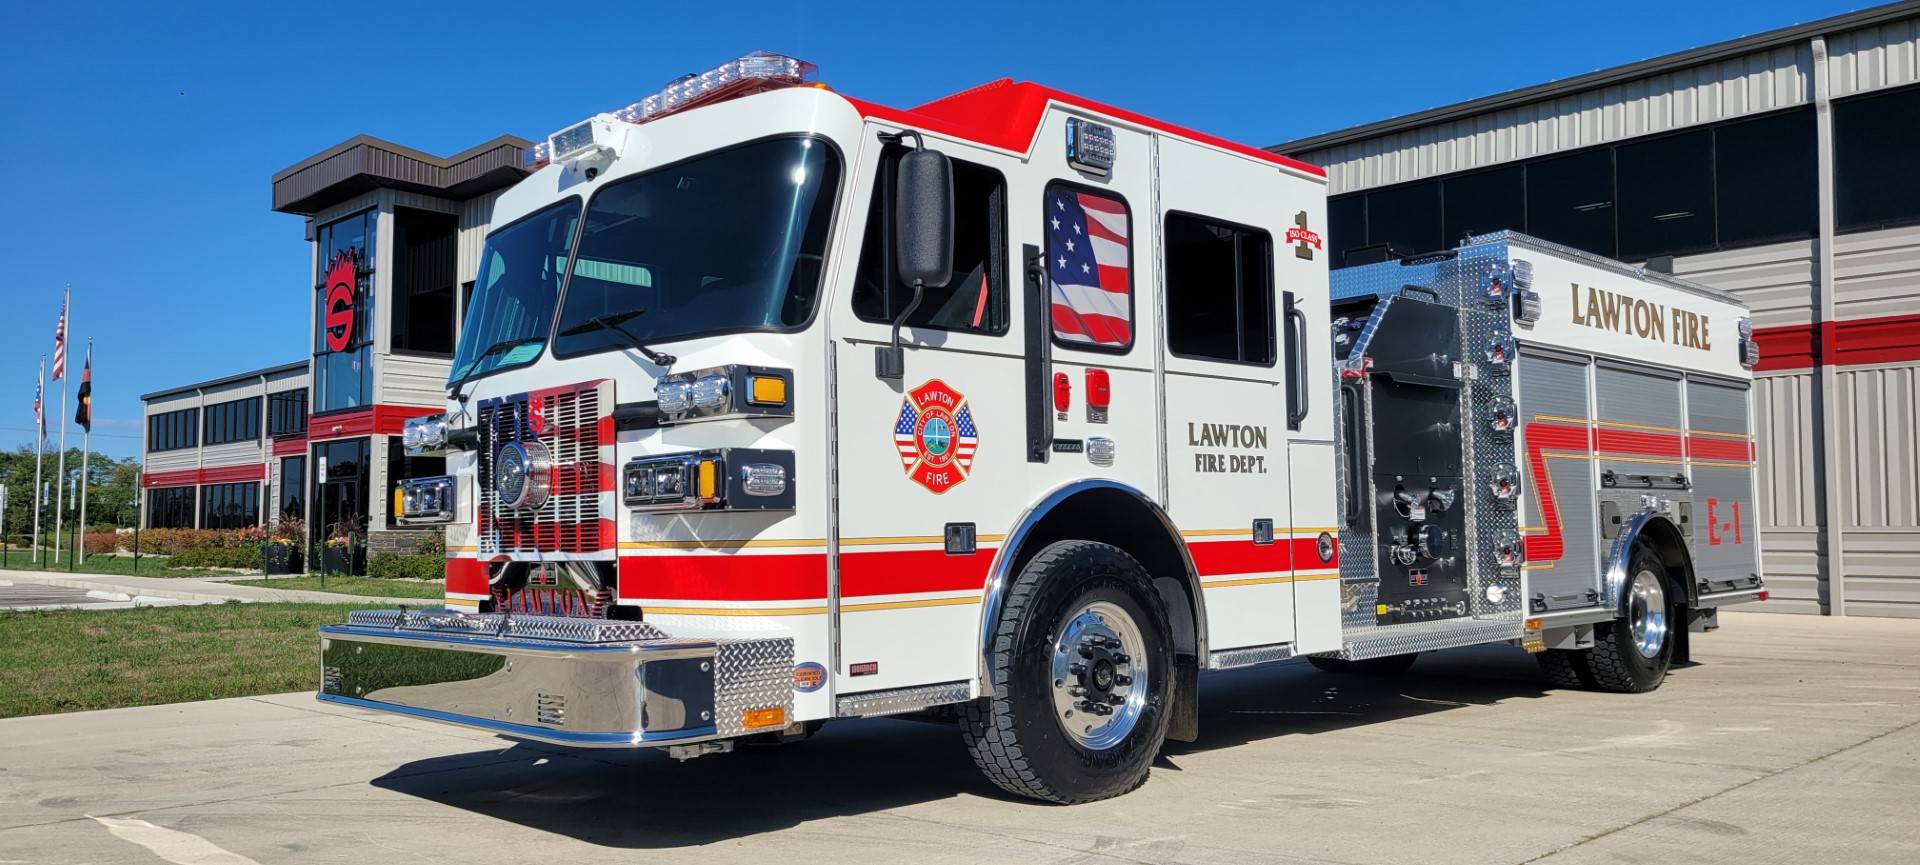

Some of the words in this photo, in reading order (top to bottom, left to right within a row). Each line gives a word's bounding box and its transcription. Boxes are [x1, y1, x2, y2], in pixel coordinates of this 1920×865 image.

[1290, 230, 1299, 238] ISO
[1300, 231, 1318, 243] CLASS
[1295, 210, 1313, 261] 1
[1571, 283, 1664, 343] LAWTON
[1671, 307, 1711, 351] FIRE
[918, 391, 954, 407] LAWTON
[917, 417, 927, 436] CITY
[926, 410, 934, 418] OF
[936, 410, 956, 437] LAWTON
[1188, 422, 1267, 449] LAWTON
[923, 451, 935, 463] EST.
[1195, 453, 1226, 473] FIRE
[1229, 454, 1267, 474] DEPT.
[925, 472, 950, 485] FIRE
[1706, 497, 1742, 546] E-1
[507, 588, 589, 616] LAWTON
